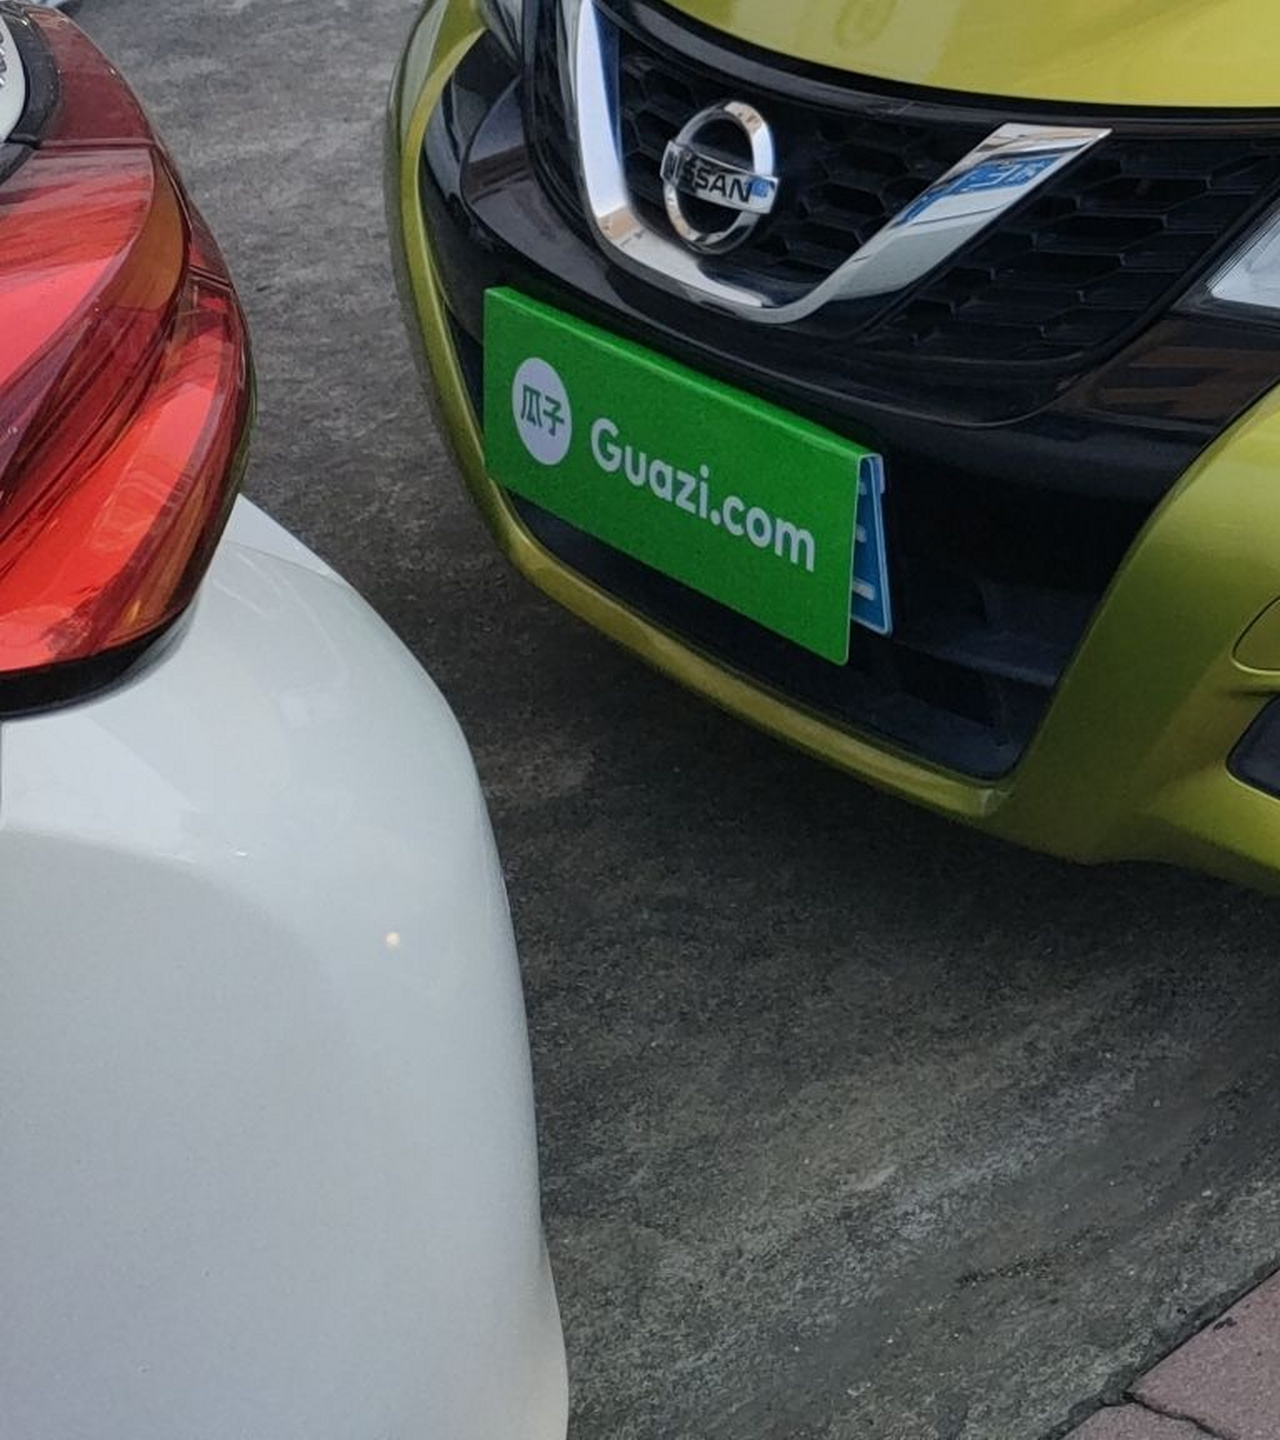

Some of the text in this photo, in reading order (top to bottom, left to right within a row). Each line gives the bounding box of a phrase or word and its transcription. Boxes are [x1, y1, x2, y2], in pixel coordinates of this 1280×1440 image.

[663, 148, 753, 204] NISSAN
[520, 383, 565, 438] 瓜子
[590, 416, 816, 573] Guazi.com
